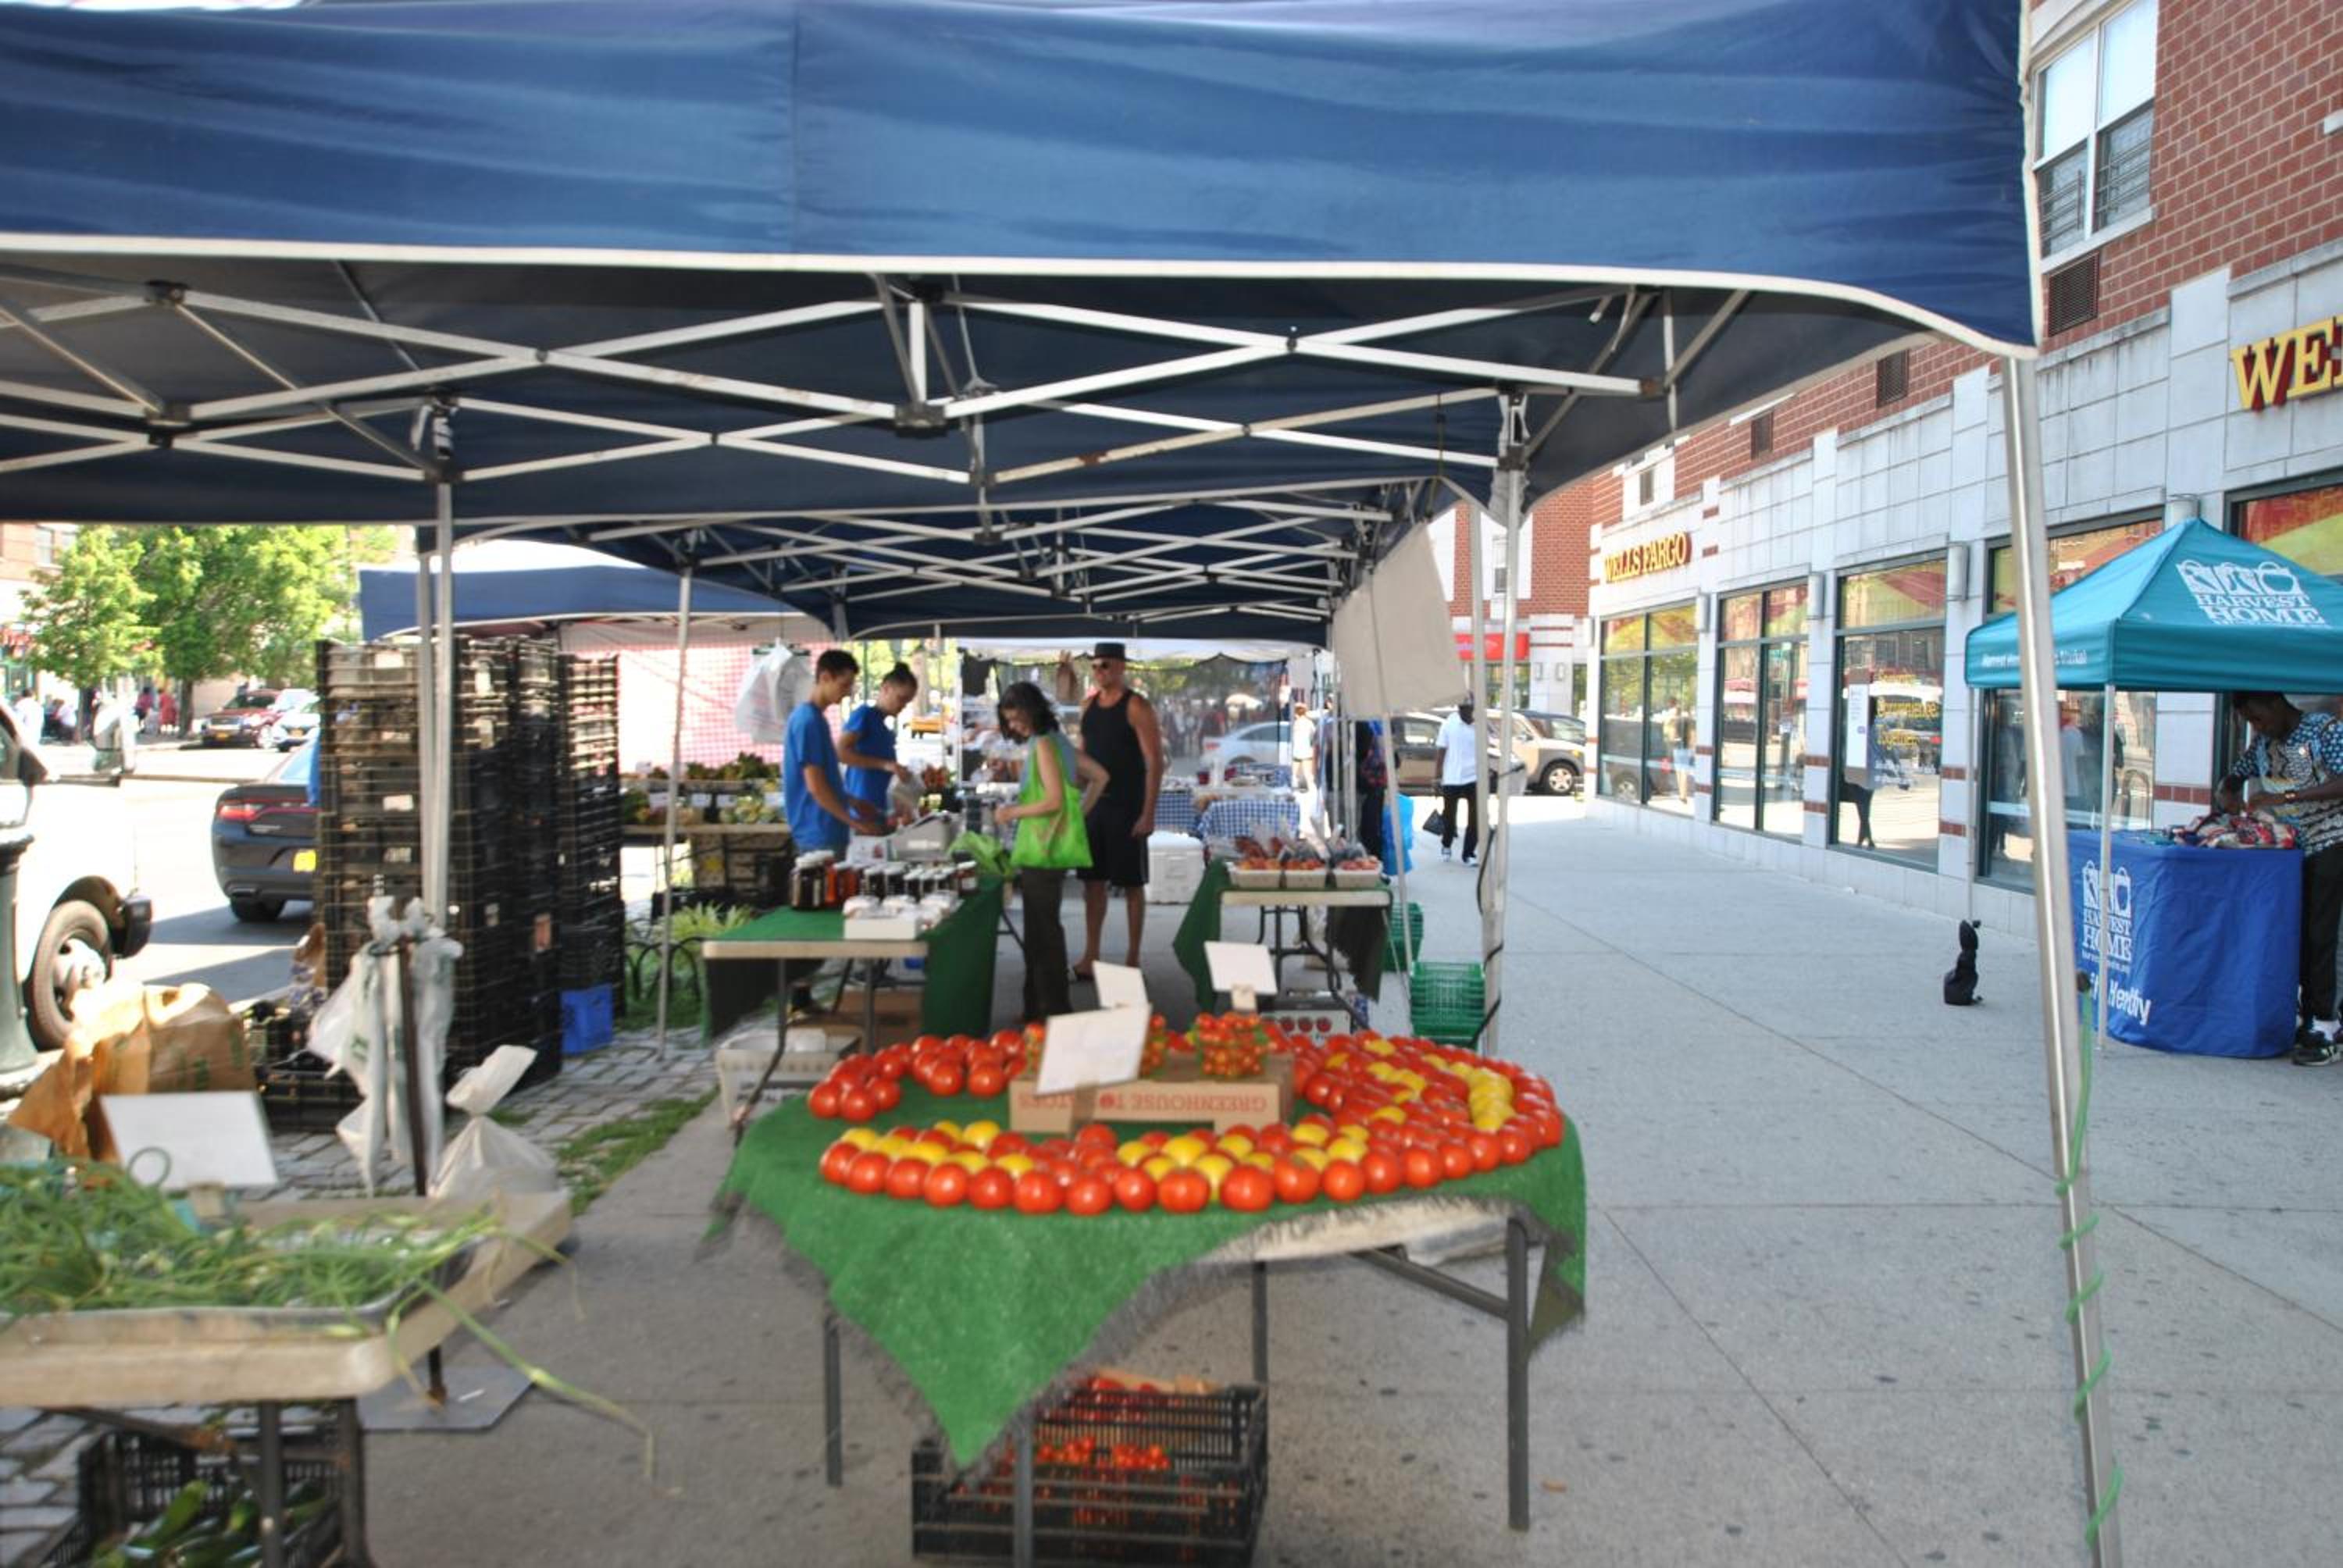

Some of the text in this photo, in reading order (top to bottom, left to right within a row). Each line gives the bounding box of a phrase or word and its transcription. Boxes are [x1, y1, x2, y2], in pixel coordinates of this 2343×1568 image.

[2231, 315, 2343, 411] WE
[1606, 532, 1689, 582] WELLS FARGO
[2195, 593, 2312, 608] HARVEST
[2199, 605, 2327, 625] HOME
[2084, 907, 2131, 935] HAEST
[1130, 1094, 1268, 1112] GREENHOUSE
